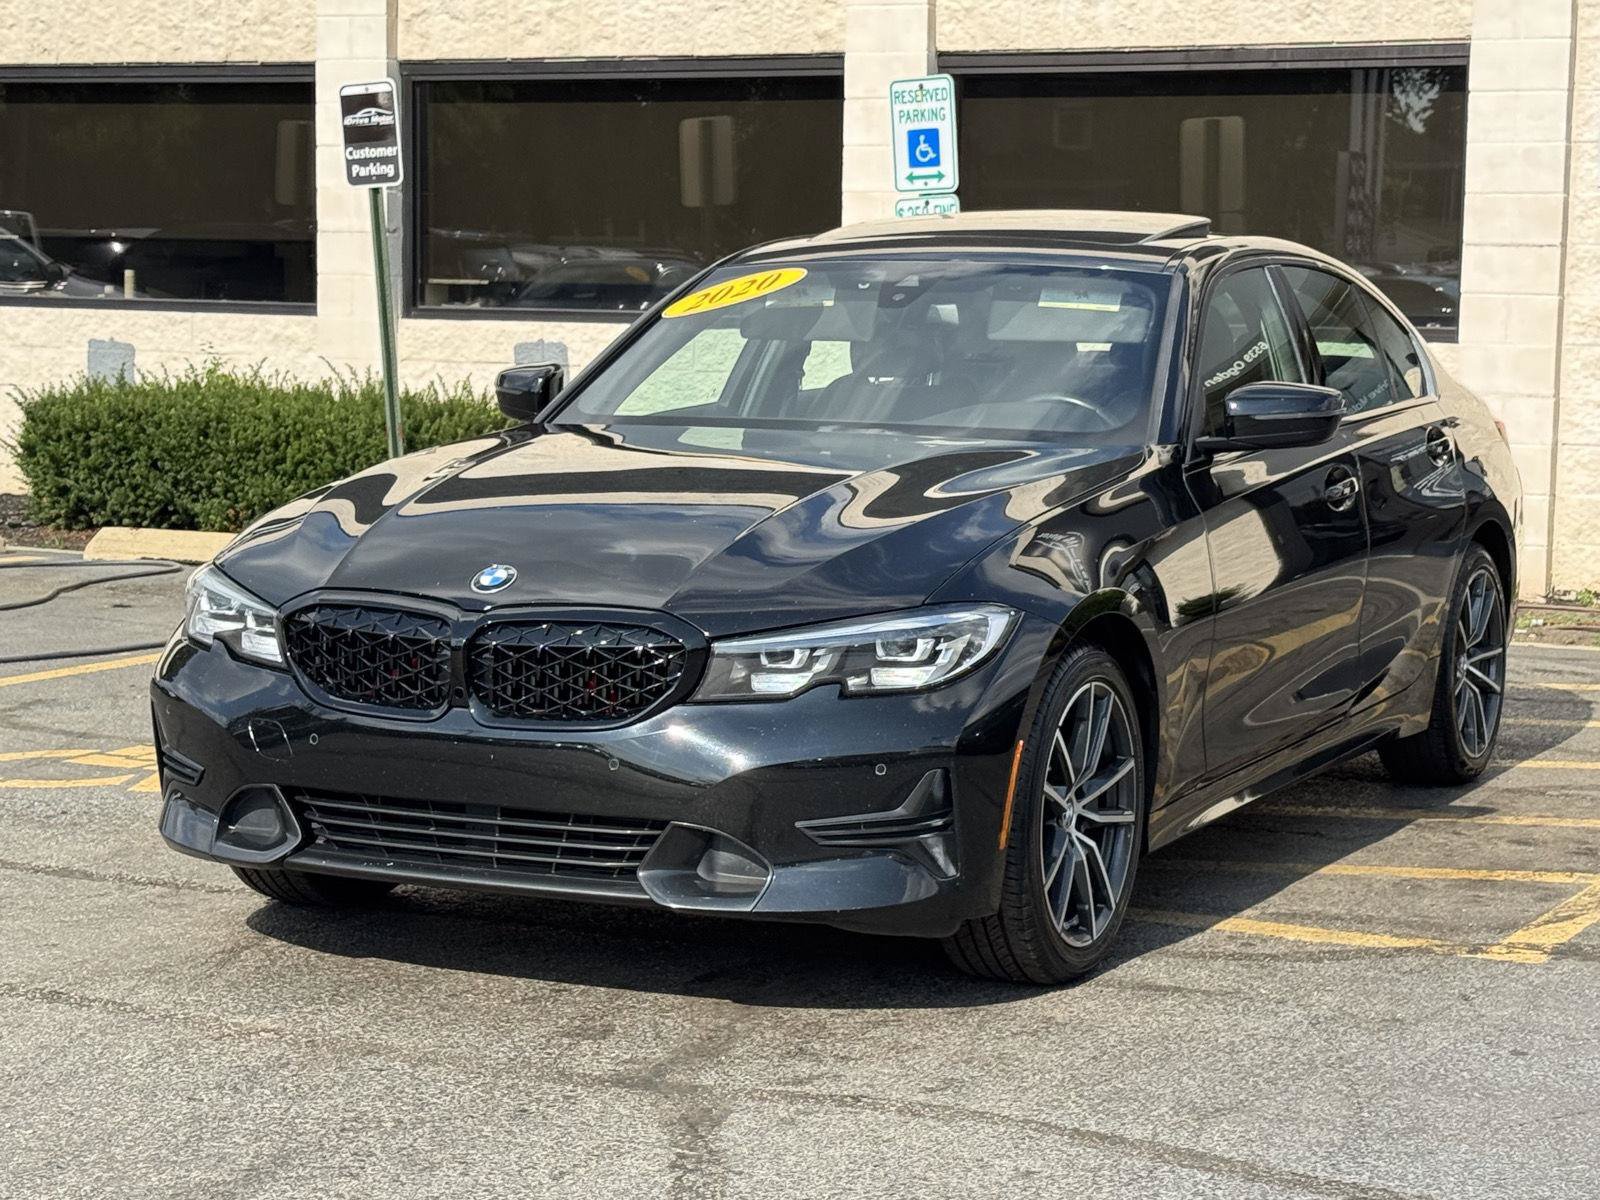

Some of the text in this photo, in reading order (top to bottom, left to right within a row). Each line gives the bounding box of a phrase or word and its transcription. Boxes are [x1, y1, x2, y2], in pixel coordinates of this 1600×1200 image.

[893, 88, 948, 104] RESERVED
[899, 107, 946, 124] PARKING
[345, 146, 398, 160] Customer
[351, 162, 395, 178] Parking
[683, 273, 782, 312] 2020
